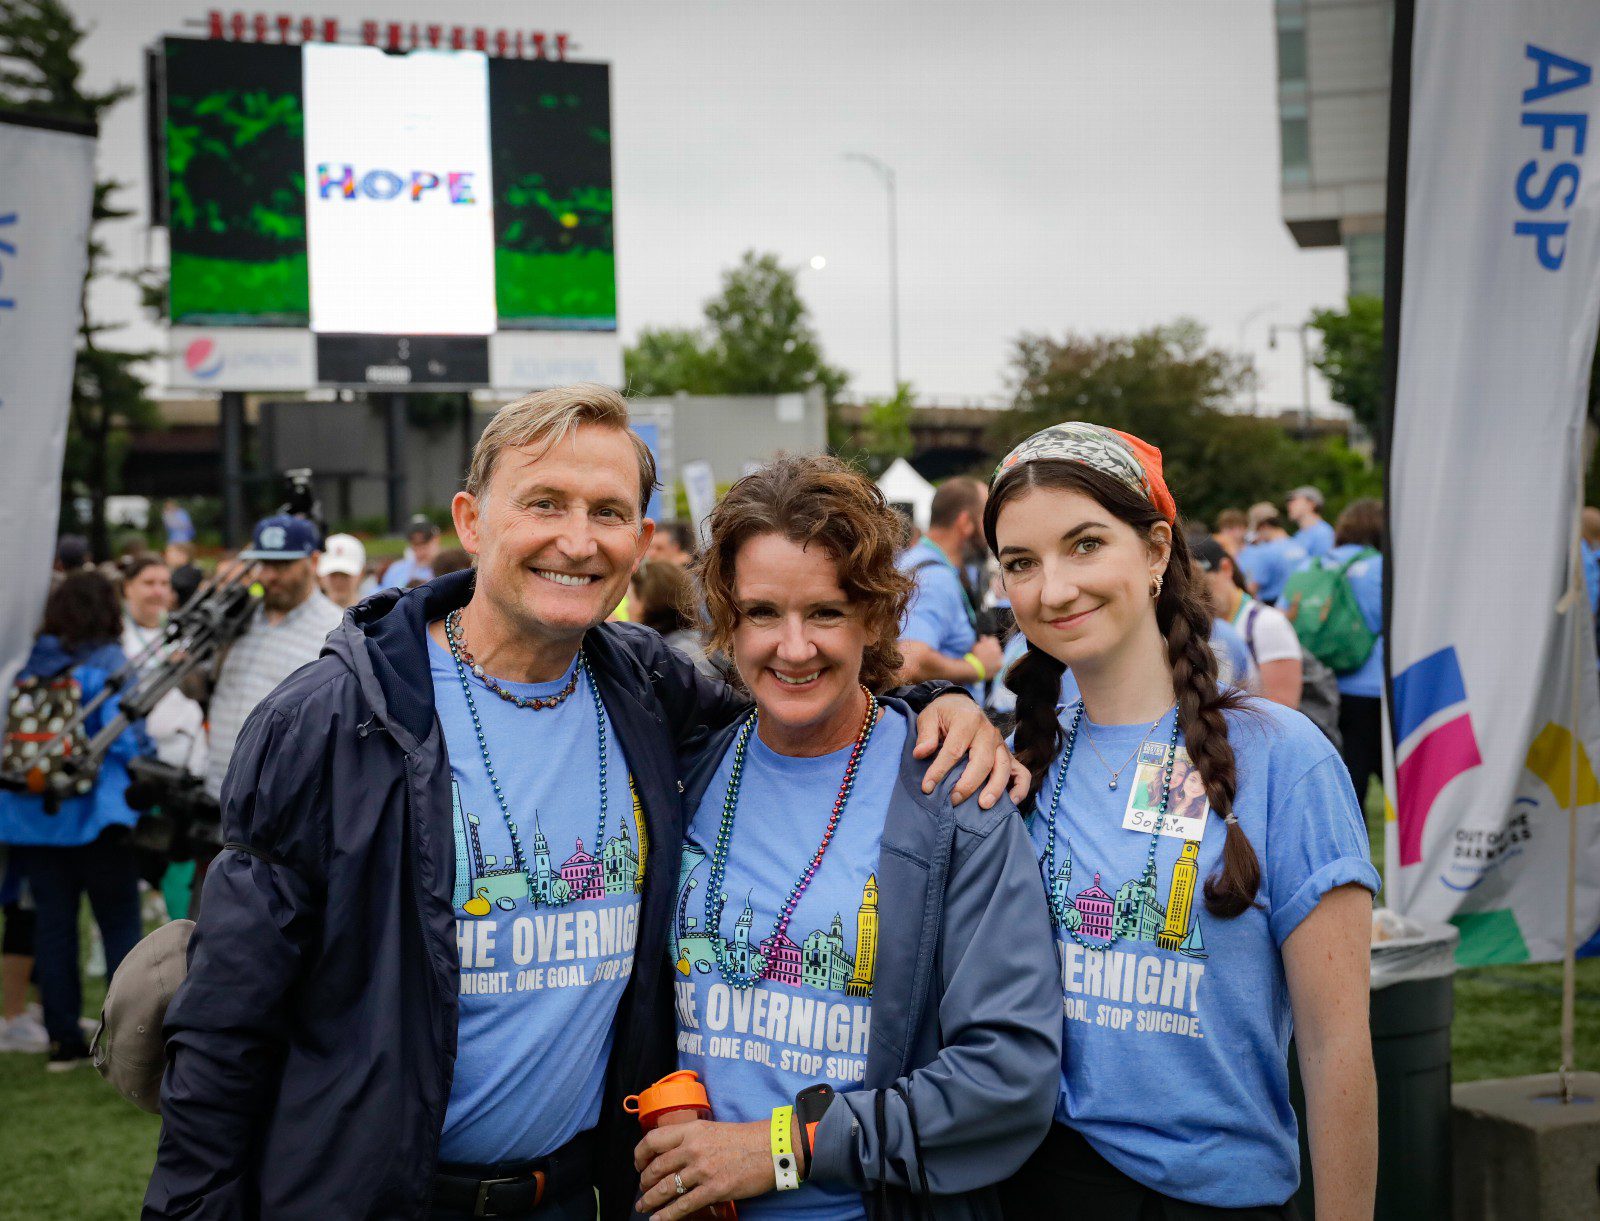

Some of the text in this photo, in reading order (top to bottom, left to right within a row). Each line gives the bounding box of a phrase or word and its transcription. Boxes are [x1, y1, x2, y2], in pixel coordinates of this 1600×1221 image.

[1514, 44, 1592, 272] AFSP
[317, 163, 477, 204] HOPE
[456, 902, 642, 968] HE OVERNIG
[460, 971, 513, 995] NIGHT.
[516, 968, 545, 991] ONE
[547, 964, 592, 988] GOAL.
[593, 959, 620, 982] STOP
[674, 981, 872, 1055] HE OVERNIGH
[1096, 1004, 1133, 1031] STOP
[1136, 1010, 1204, 1039] SUICIDE.
[709, 1036, 741, 1060] ONE
[779, 1049, 823, 1077] STOP
[826, 1057, 868, 1082] SUIC
